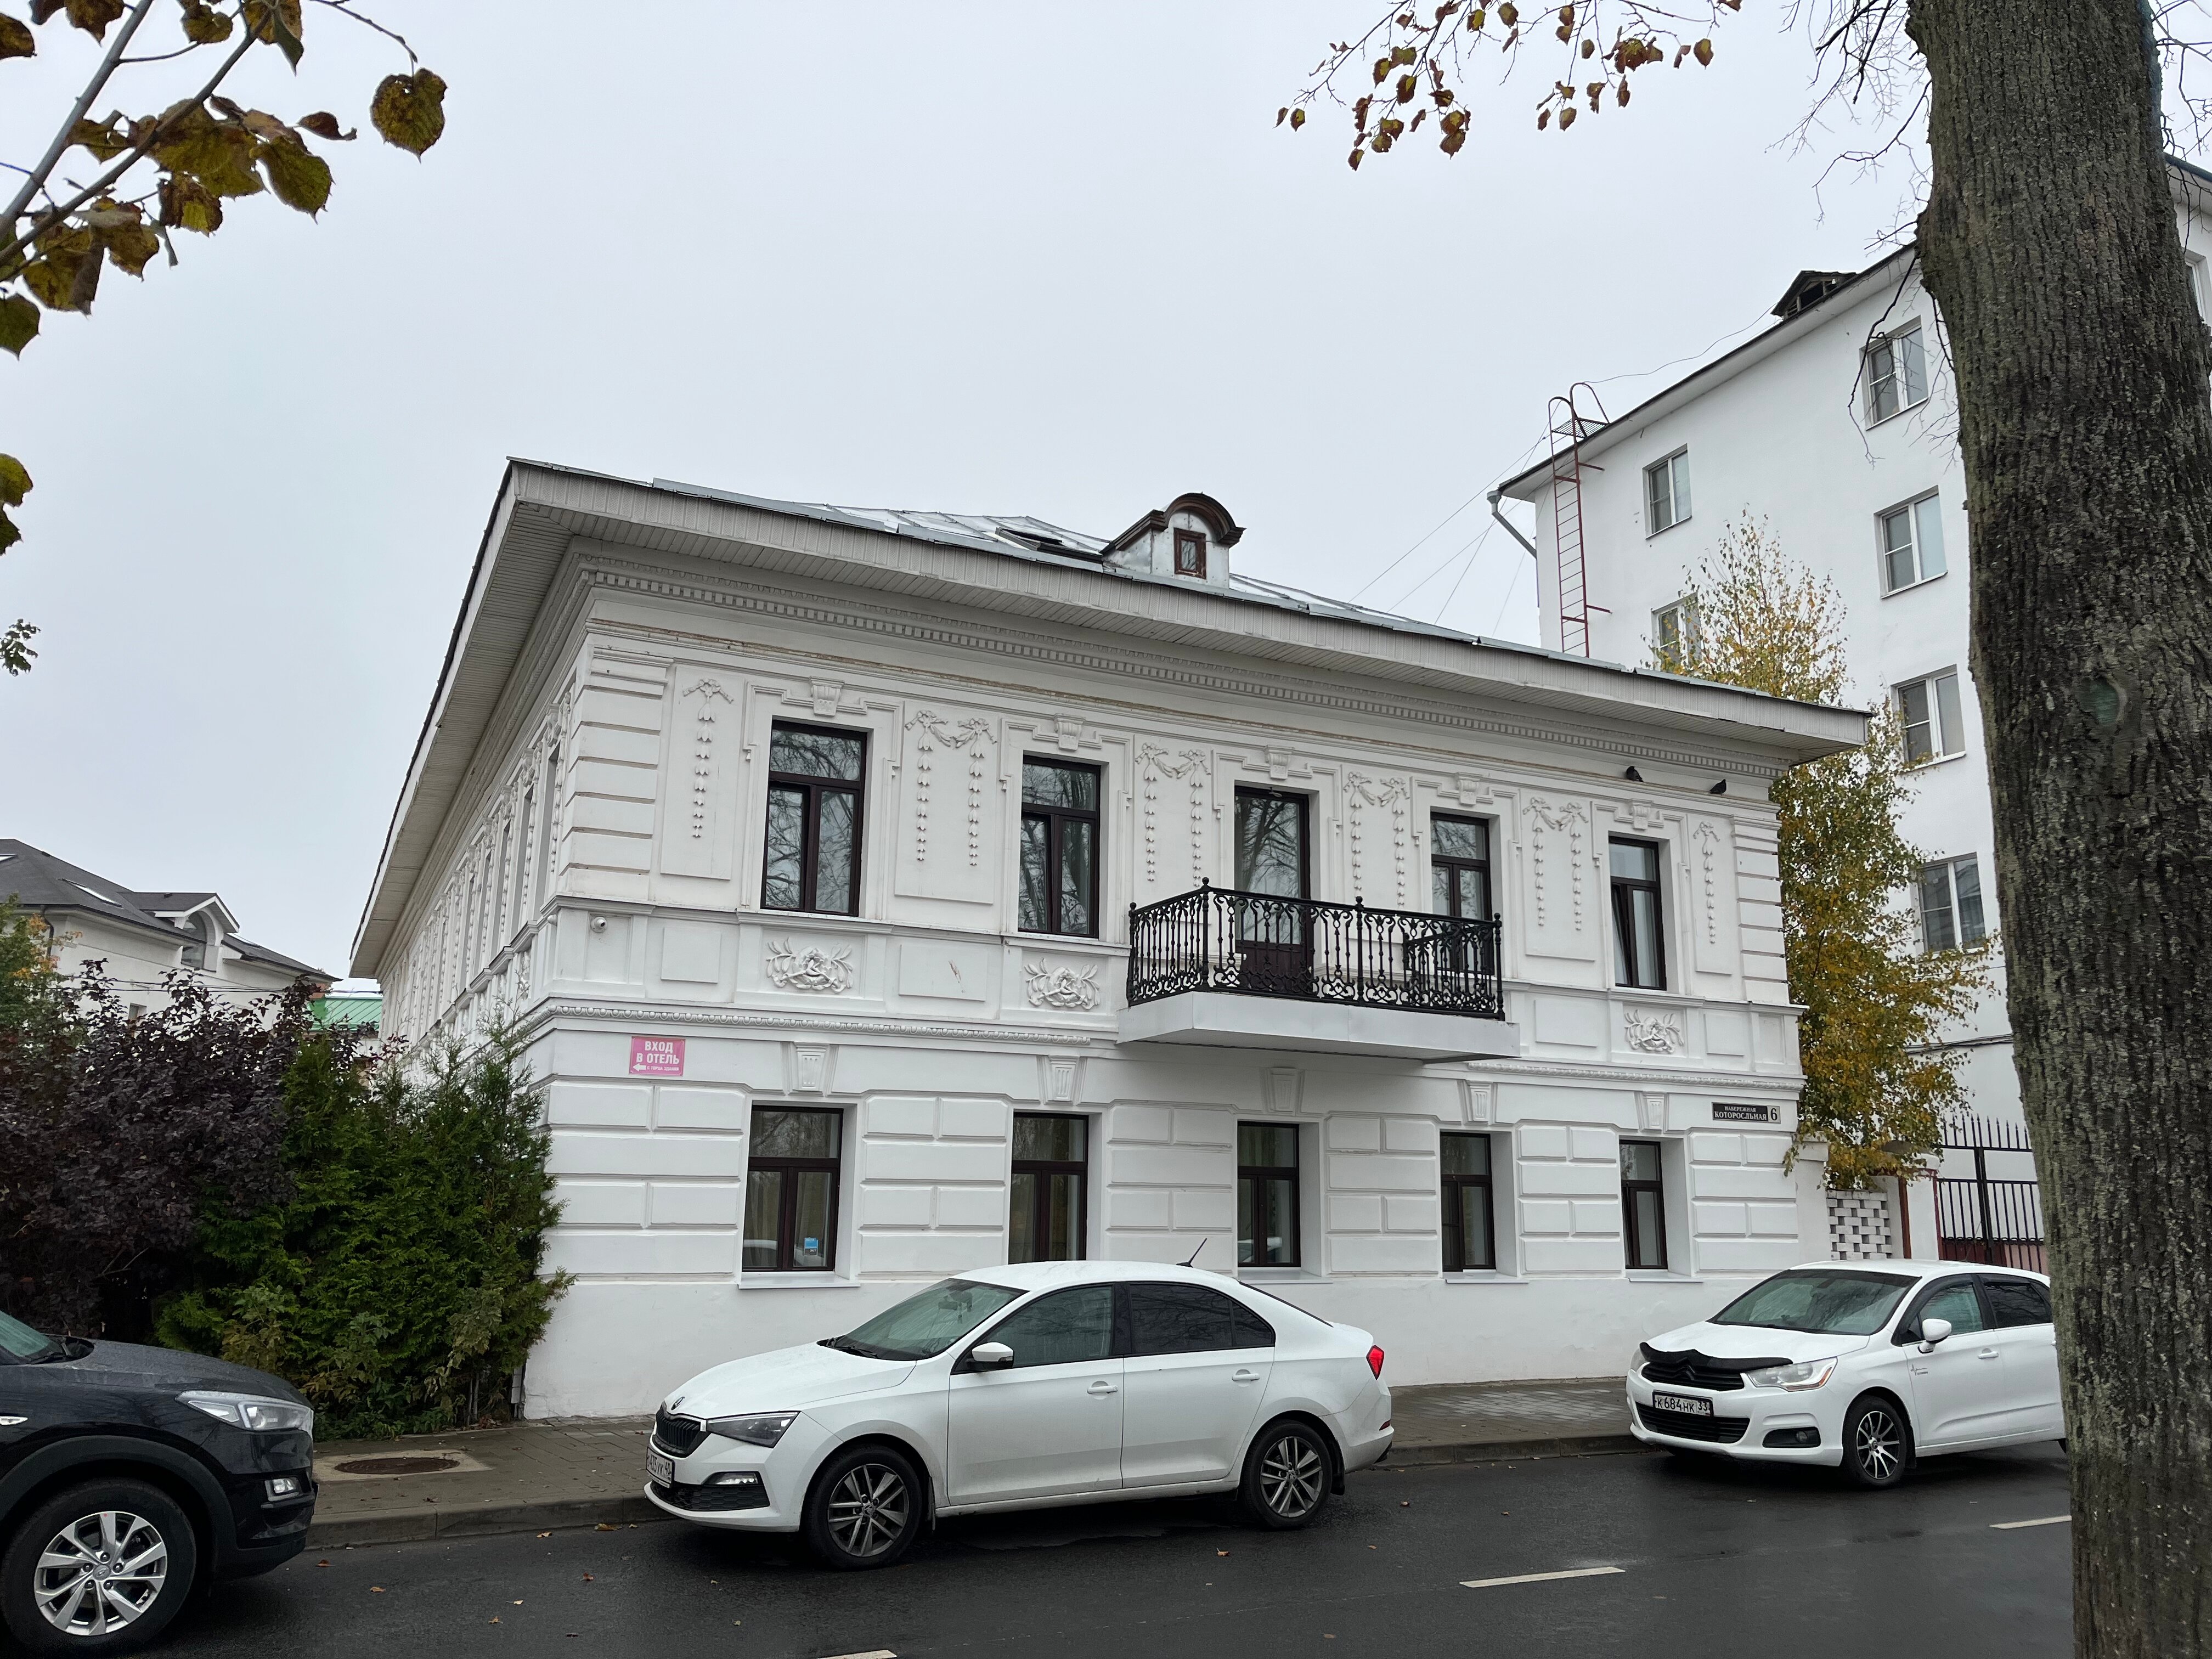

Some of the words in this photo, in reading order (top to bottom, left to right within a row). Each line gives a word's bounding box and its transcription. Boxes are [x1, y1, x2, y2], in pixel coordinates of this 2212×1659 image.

[645, 1041, 673, 1053] ВХОД
[636, 1053, 643, 1063] В
[646, 1053, 680, 1064] ОТЕЛЬ
[1714, 1111, 1767, 1120] КОТОРОСЛЬНАЯ
[1770, 1108, 1778, 1121] 6
